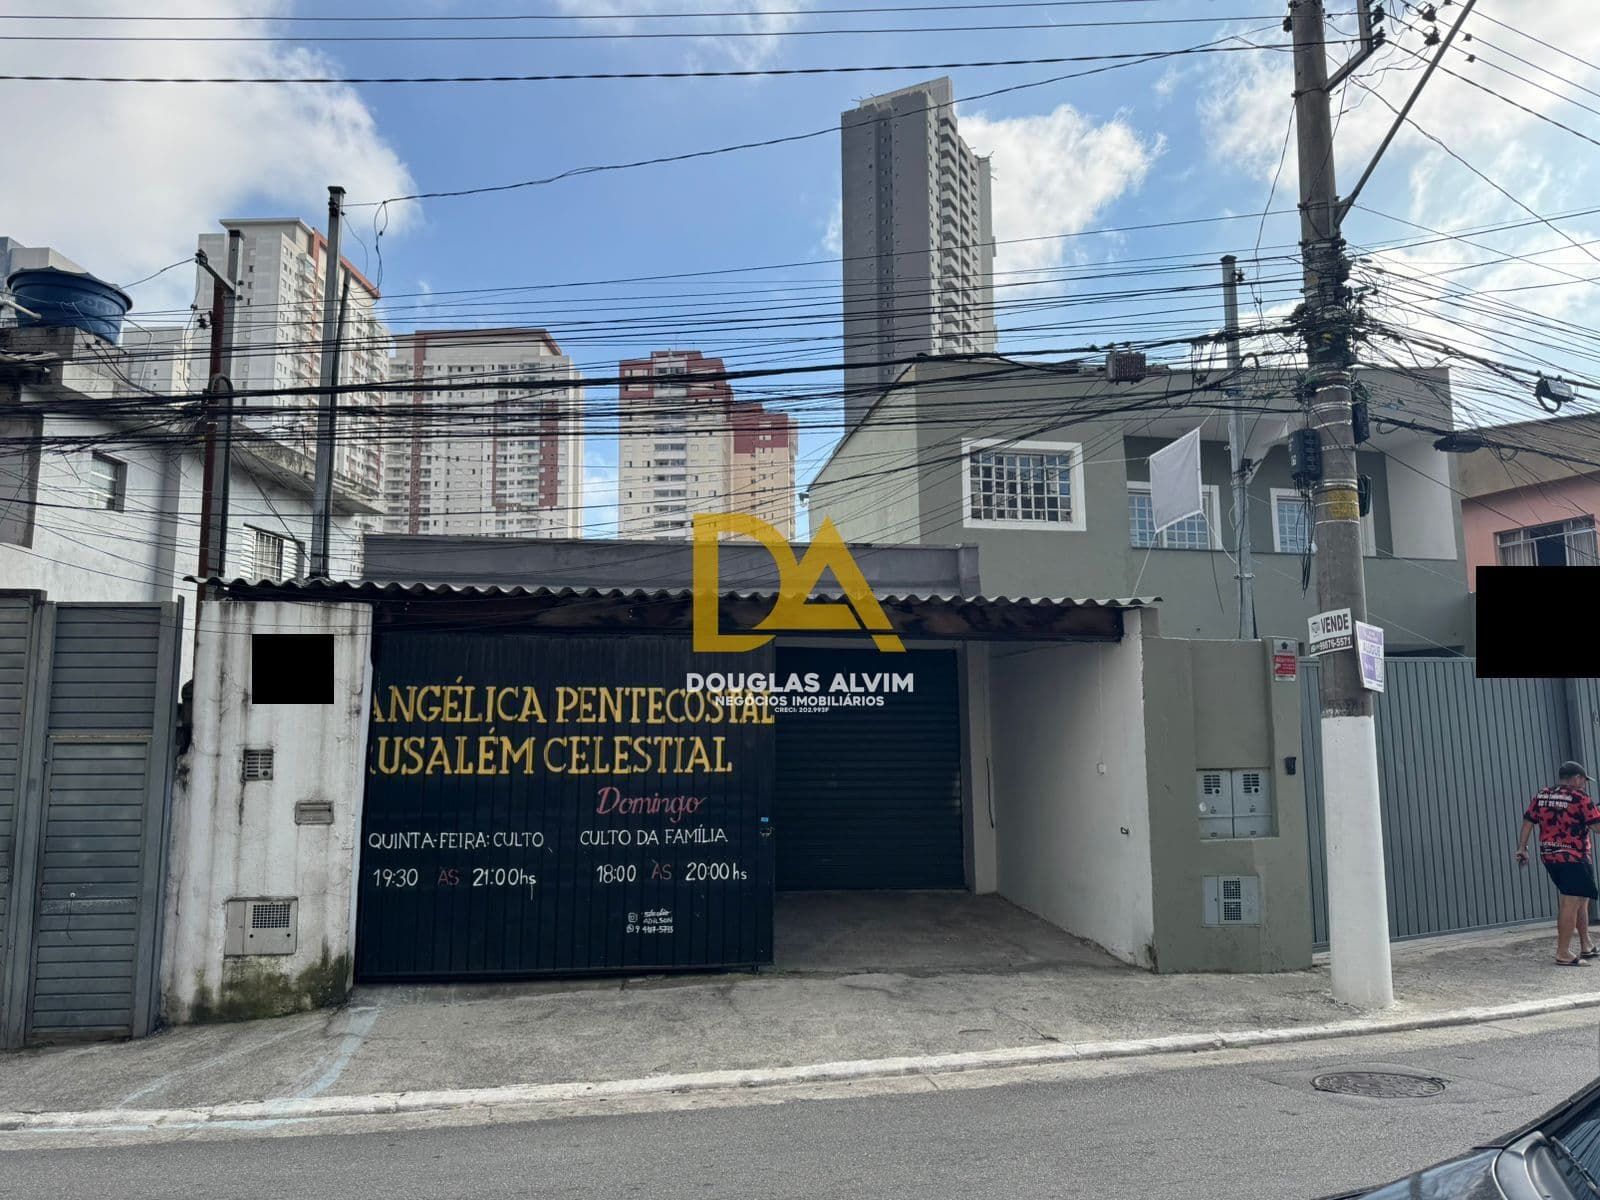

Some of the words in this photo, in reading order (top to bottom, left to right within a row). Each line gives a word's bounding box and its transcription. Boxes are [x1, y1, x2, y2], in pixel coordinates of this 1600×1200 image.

[1320, 613, 1350, 634] VENDE
[555, 686, 776, 724] PENTECOSTAL
[370, 729, 536, 775] USALÉM
[543, 736, 733, 775] CELESTIAL
[596, 786, 708, 823] Domingo
[368, 831, 490, 850] QUINTA-FEIRA:
[493, 831, 544, 848] CULTO
[580, 830, 632, 846] CULTO
[636, 829, 660, 845] DA
[664, 823, 728, 845] FAMÍLIA
[373, 868, 419, 888] 19:30
[472, 868, 537, 887] 21:00hs
[596, 864, 637, 883] 18:00
